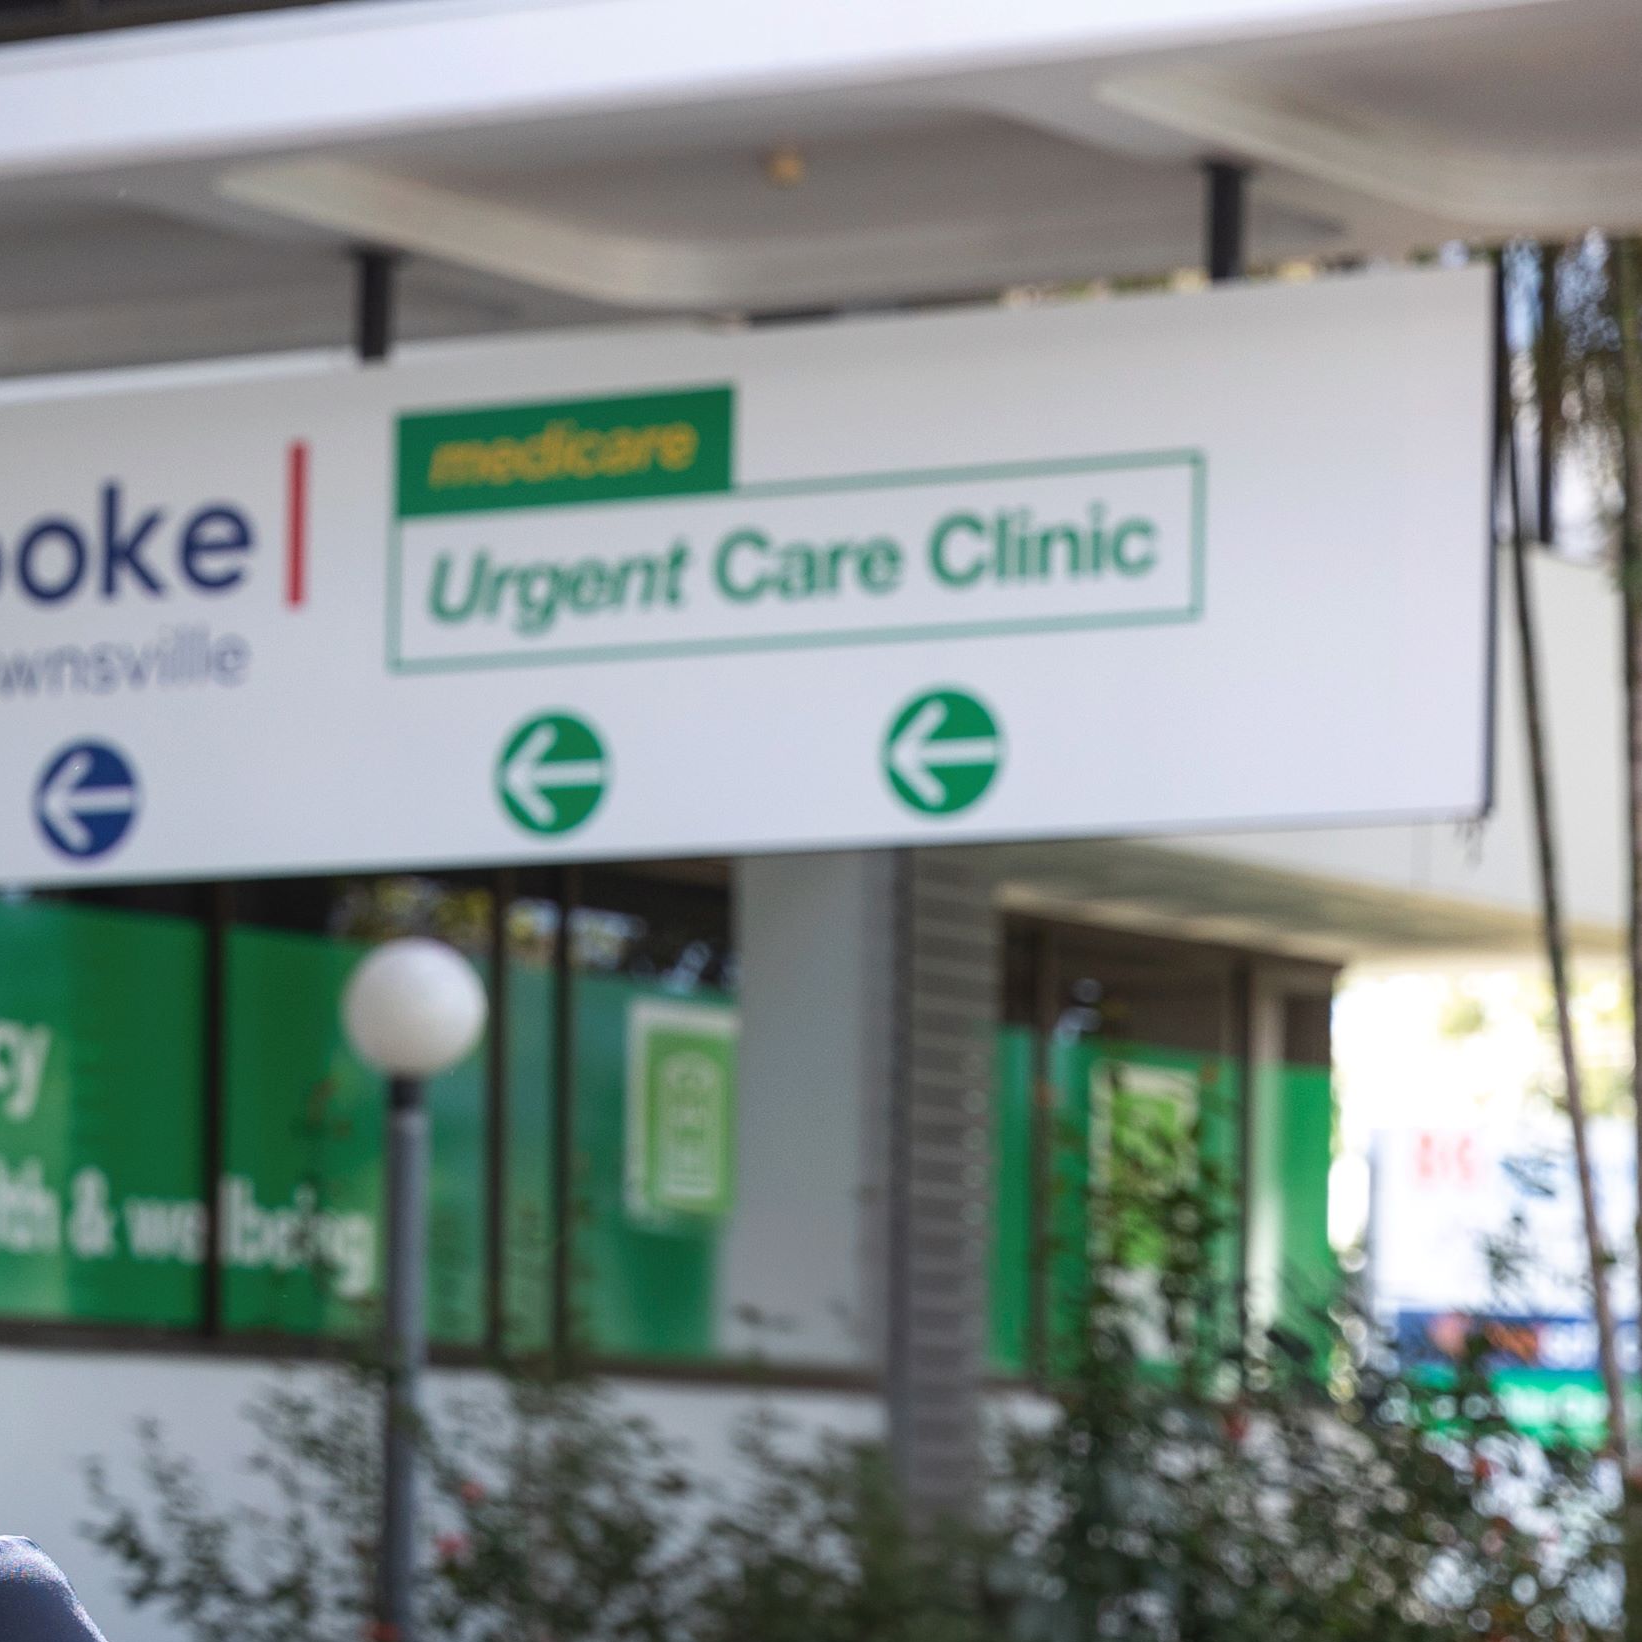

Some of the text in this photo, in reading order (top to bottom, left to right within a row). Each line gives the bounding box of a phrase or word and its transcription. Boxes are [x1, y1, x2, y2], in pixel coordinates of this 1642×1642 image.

[428, 417, 697, 490] medicare
[428, 502, 1159, 635] Urgent Care Clinic
[69, 1164, 117, 1260] &
